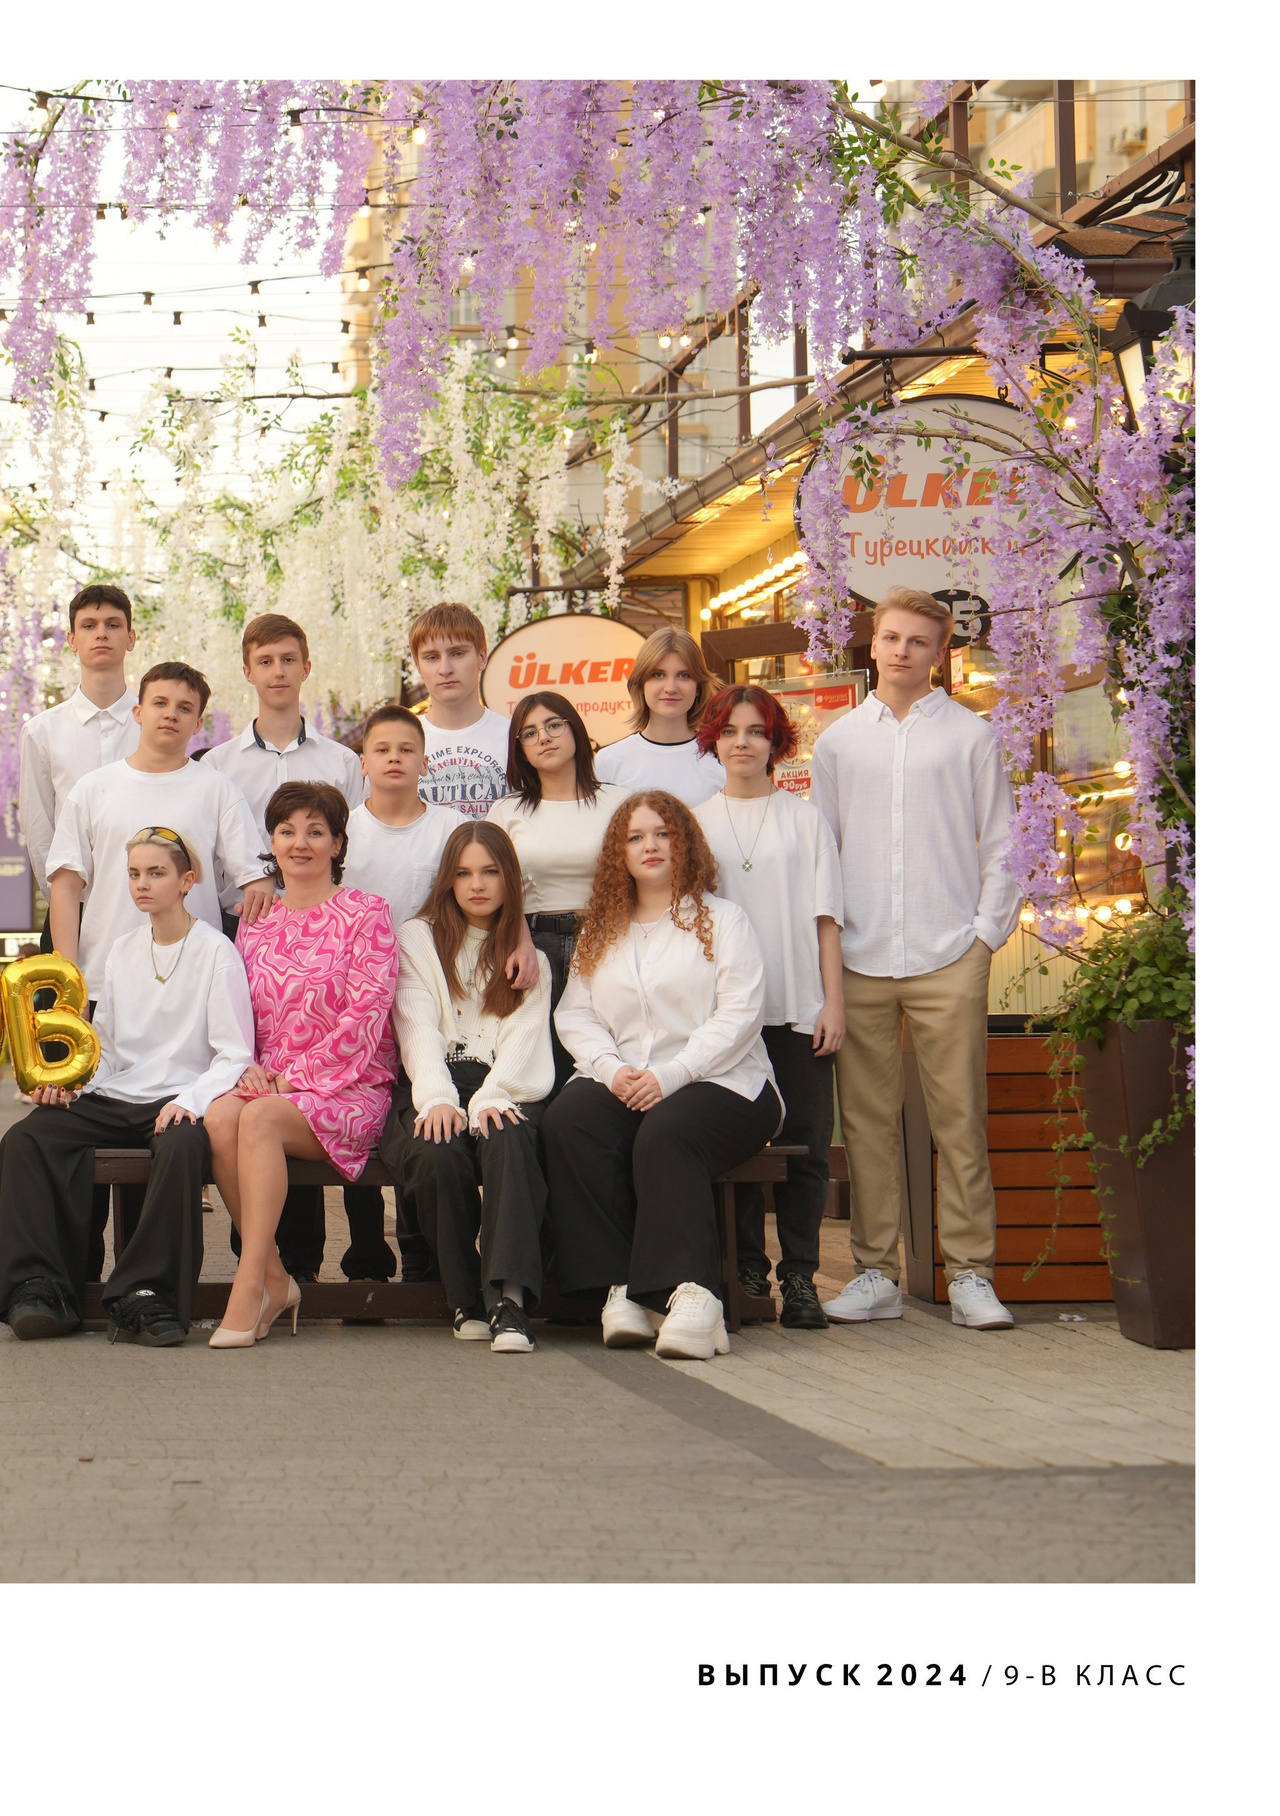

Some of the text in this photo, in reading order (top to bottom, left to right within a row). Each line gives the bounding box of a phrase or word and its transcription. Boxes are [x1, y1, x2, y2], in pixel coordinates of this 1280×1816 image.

[935, 599, 982, 637] 5
[508, 652, 636, 689] ÜLKER
[429, 757, 482, 773] YACHTING
[457, 745, 507, 781] EXPLORER
[781, 769, 809, 779] АКЦИЯ
[460, 804, 493, 814] SAILI
